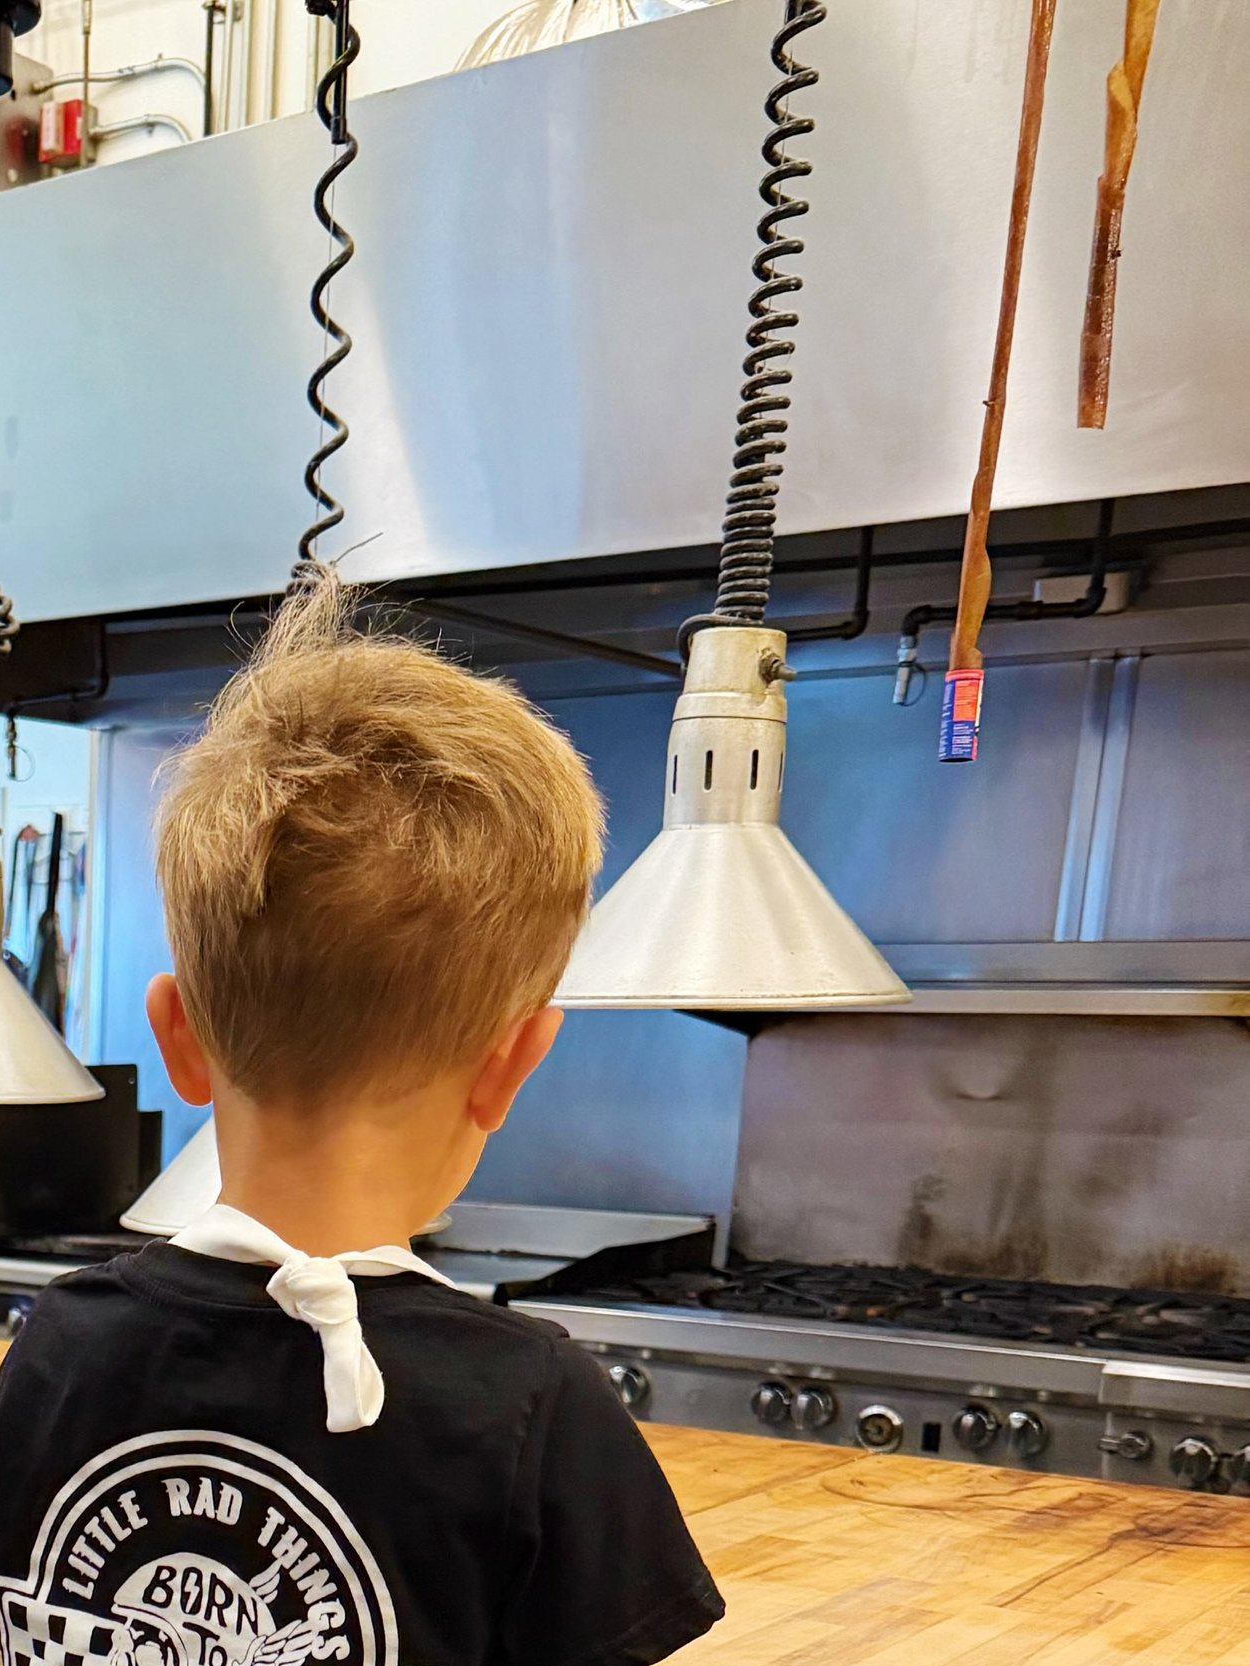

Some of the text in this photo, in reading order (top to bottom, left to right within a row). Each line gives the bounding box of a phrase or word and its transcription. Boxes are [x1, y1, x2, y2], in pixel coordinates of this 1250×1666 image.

[61, 1476, 350, 1662] LITTLE RAD THINGS
[142, 1565, 259, 1636] BORN
